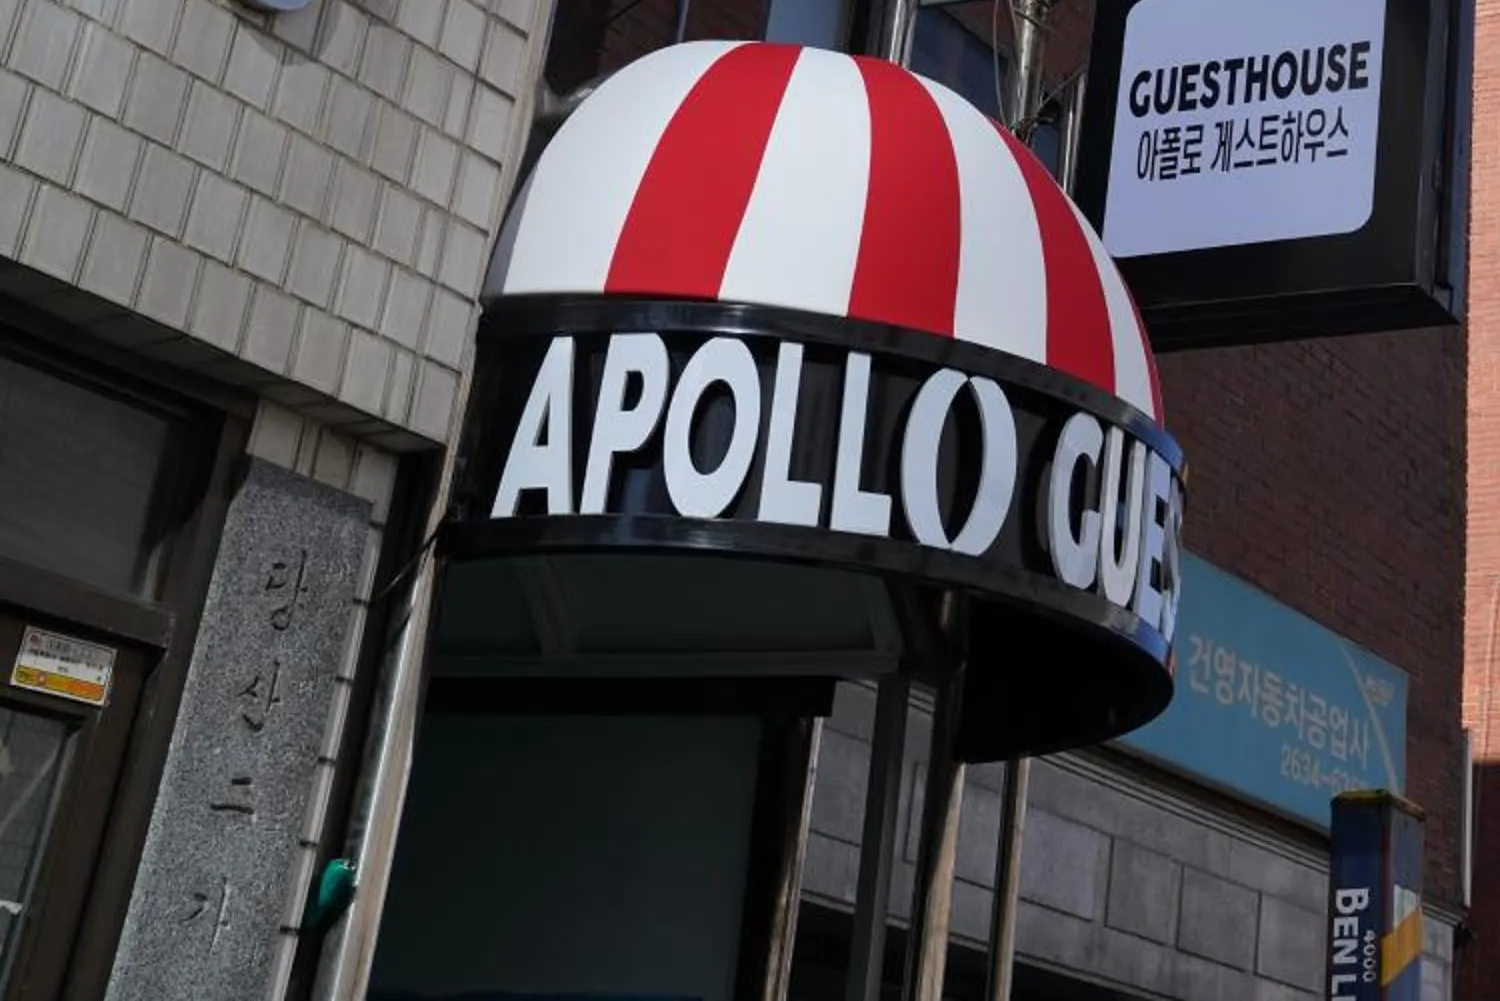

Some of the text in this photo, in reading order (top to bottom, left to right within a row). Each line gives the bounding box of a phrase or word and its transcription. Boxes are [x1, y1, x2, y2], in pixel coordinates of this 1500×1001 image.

[1129, 40, 1371, 118] GUESTHOUSE
[1136, 105, 1349, 182] 아폴로 게스트하우스
[490, 331, 1018, 557] APOLLO
[1187, 633, 1371, 772] 건영자동차공업사
[1362, 929, 1378, 983] 4000
